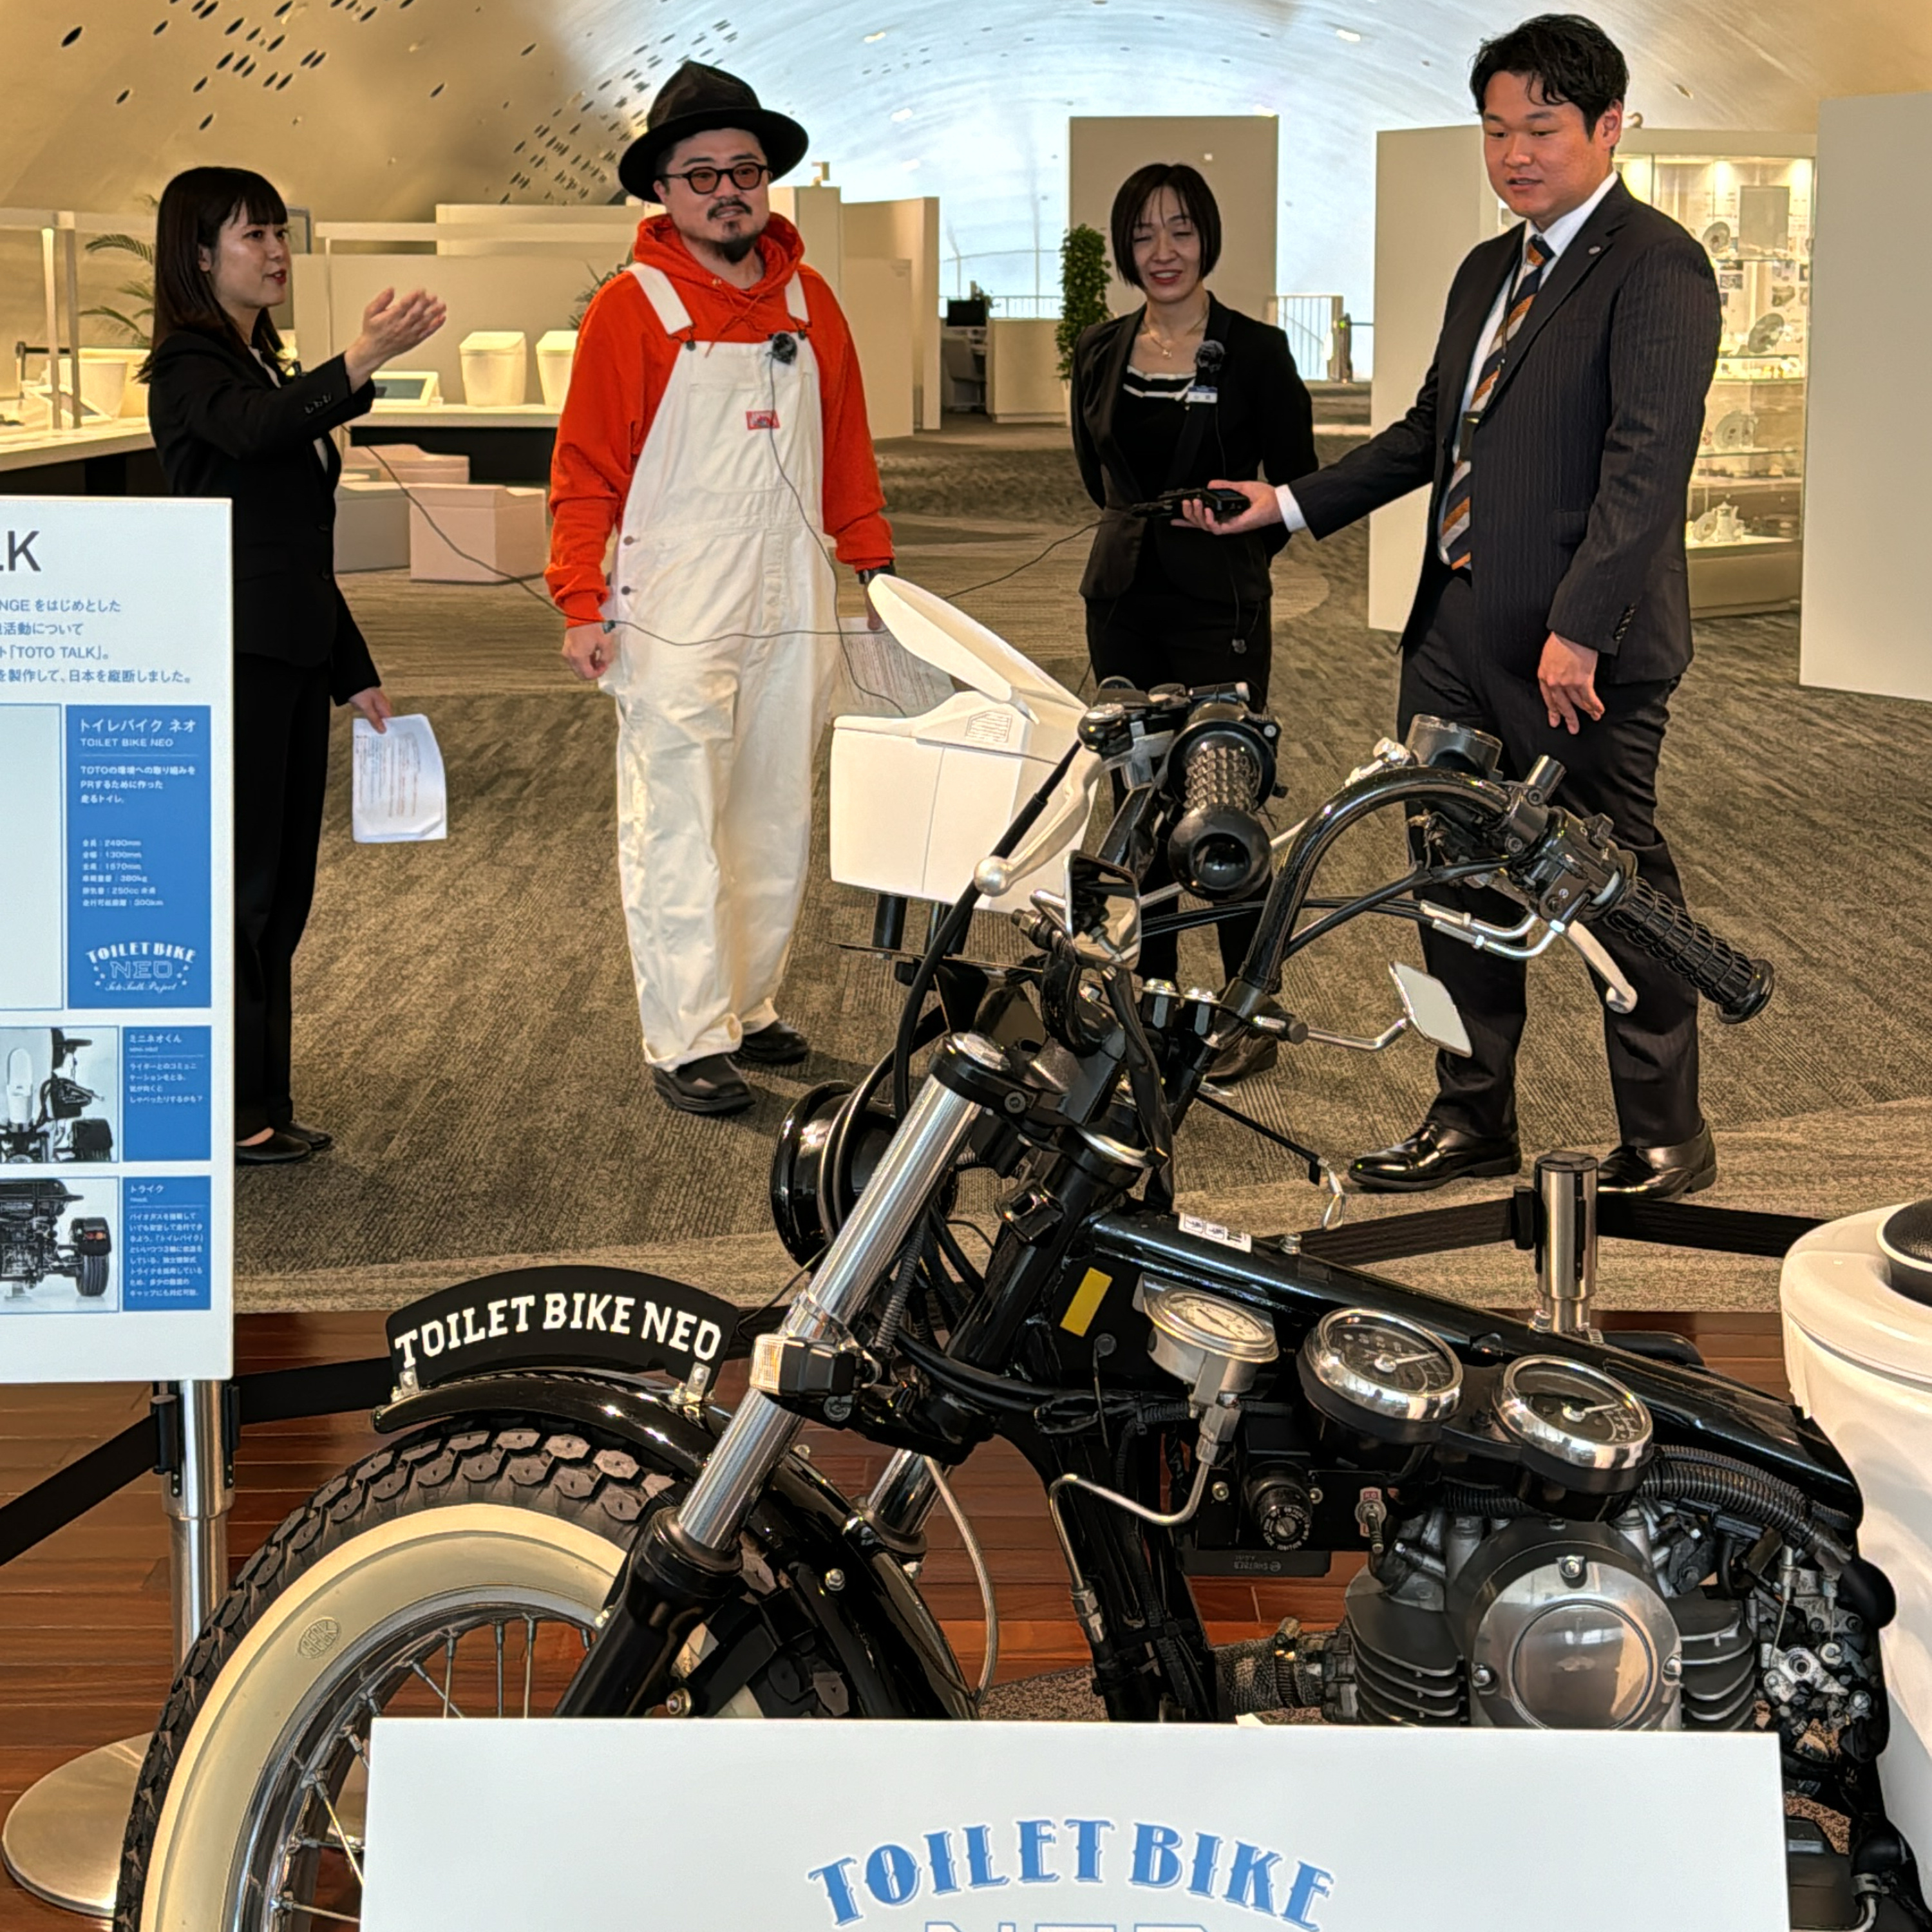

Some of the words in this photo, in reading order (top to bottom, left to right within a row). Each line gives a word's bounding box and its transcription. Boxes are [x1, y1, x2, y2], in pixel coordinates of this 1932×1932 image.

[0, 531, 41, 572] K
[35, 599, 121, 612] をはじめとした
[0, 621, 84, 636] 活動について
[80, 718, 162, 733] トイレバイク
[169, 719, 196, 733] ネオ
[80, 738, 118, 747] TOILET
[121, 738, 147, 747] BIKE
[149, 738, 175, 747] NEO
[85, 942, 151, 963] TOILET
[153, 942, 196, 964] BIKE
[109, 960, 173, 979] NEO
[130, 1184, 164, 1194] トライク
[394, 1294, 535, 1368] TOILET
[543, 1293, 635, 1335] BIKE
[640, 1301, 722, 1361] NEO
[808, 1818, 1115, 1927] TOILET
[1127, 1822, 1336, 1932] BIKE
